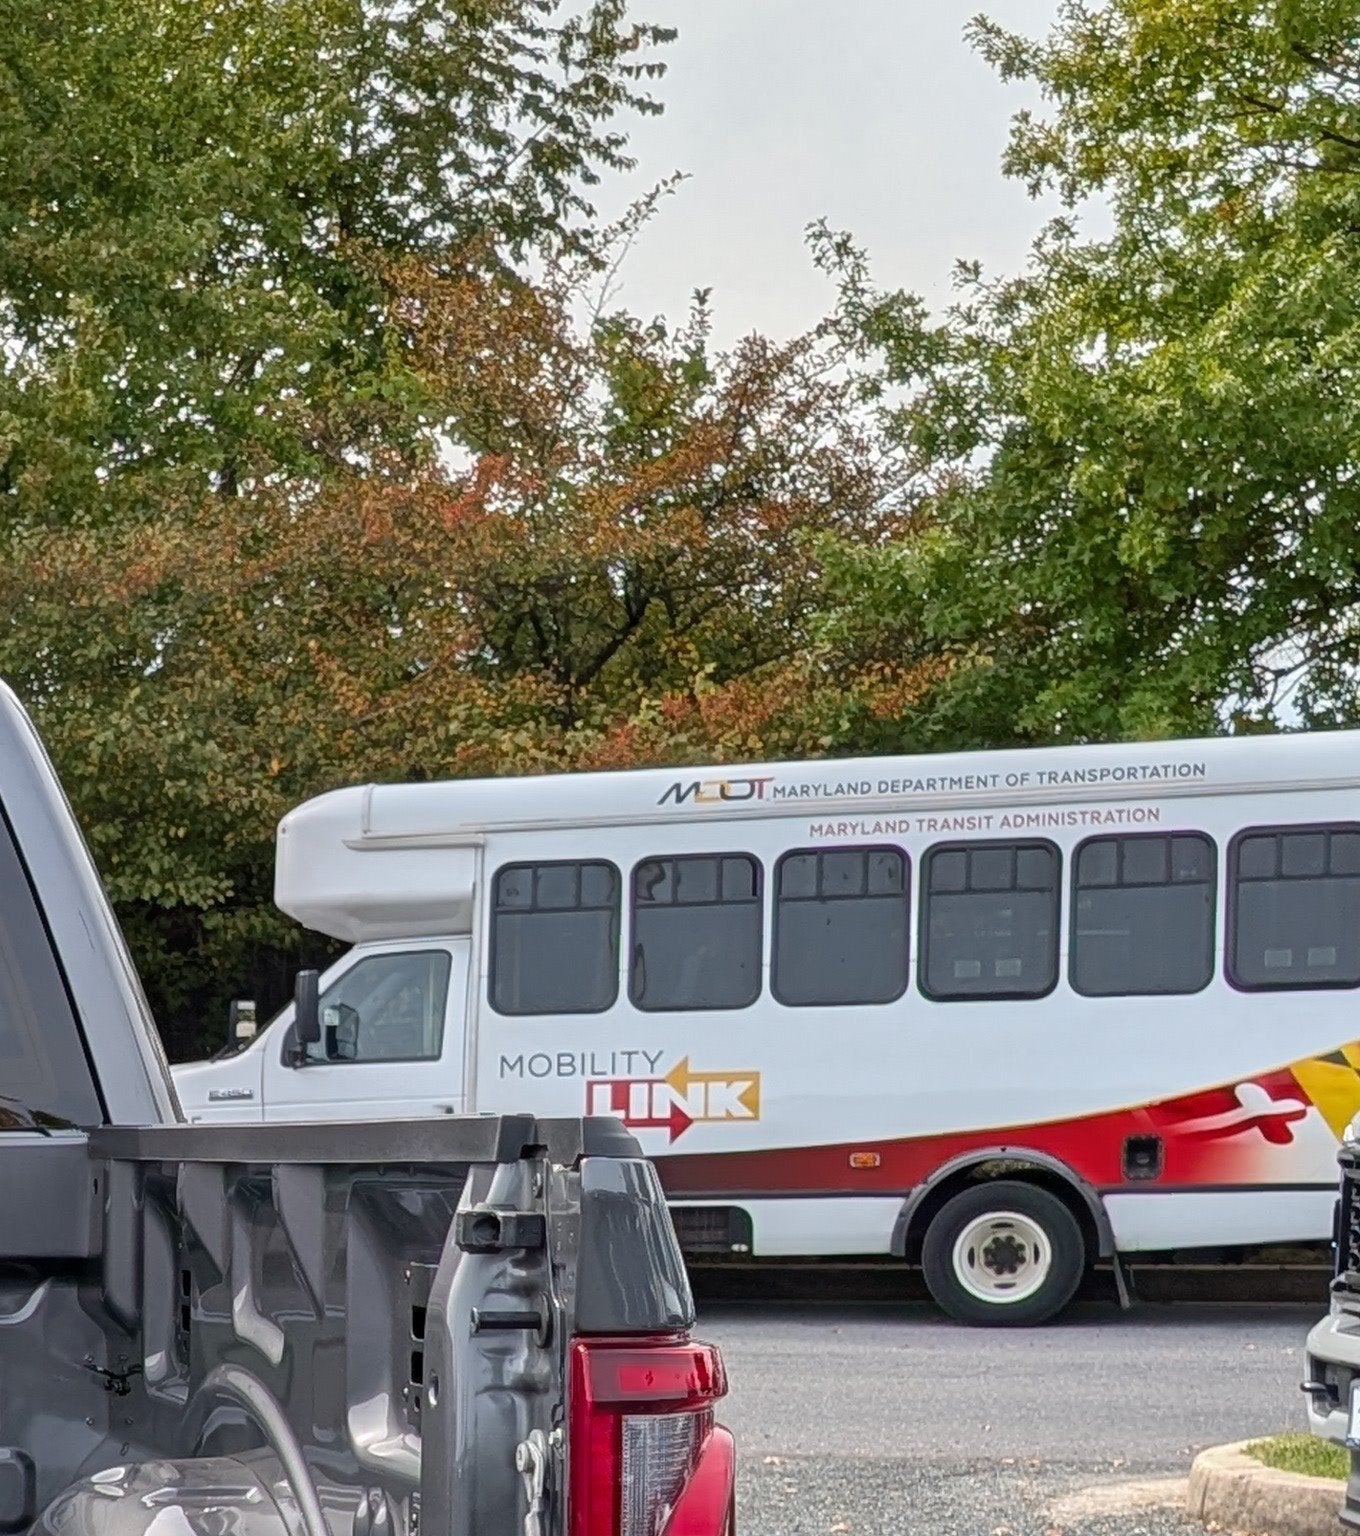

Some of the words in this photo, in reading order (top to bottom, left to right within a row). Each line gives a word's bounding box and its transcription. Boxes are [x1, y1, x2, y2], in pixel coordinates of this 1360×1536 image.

[773, 780, 872, 799] MARYLAND
[878, 774, 999, 794] DEPARTMENT
[1005, 772, 1030, 788] OF
[1037, 763, 1206, 785] TRANSPORTATION
[809, 819, 910, 838] MARYLAND
[916, 815, 994, 833] TRANSIT
[1000, 807, 1160, 829] ADMINISTRATION
[500, 1050, 664, 1078] MOBILITY
[592, 1081, 756, 1118] LINK
